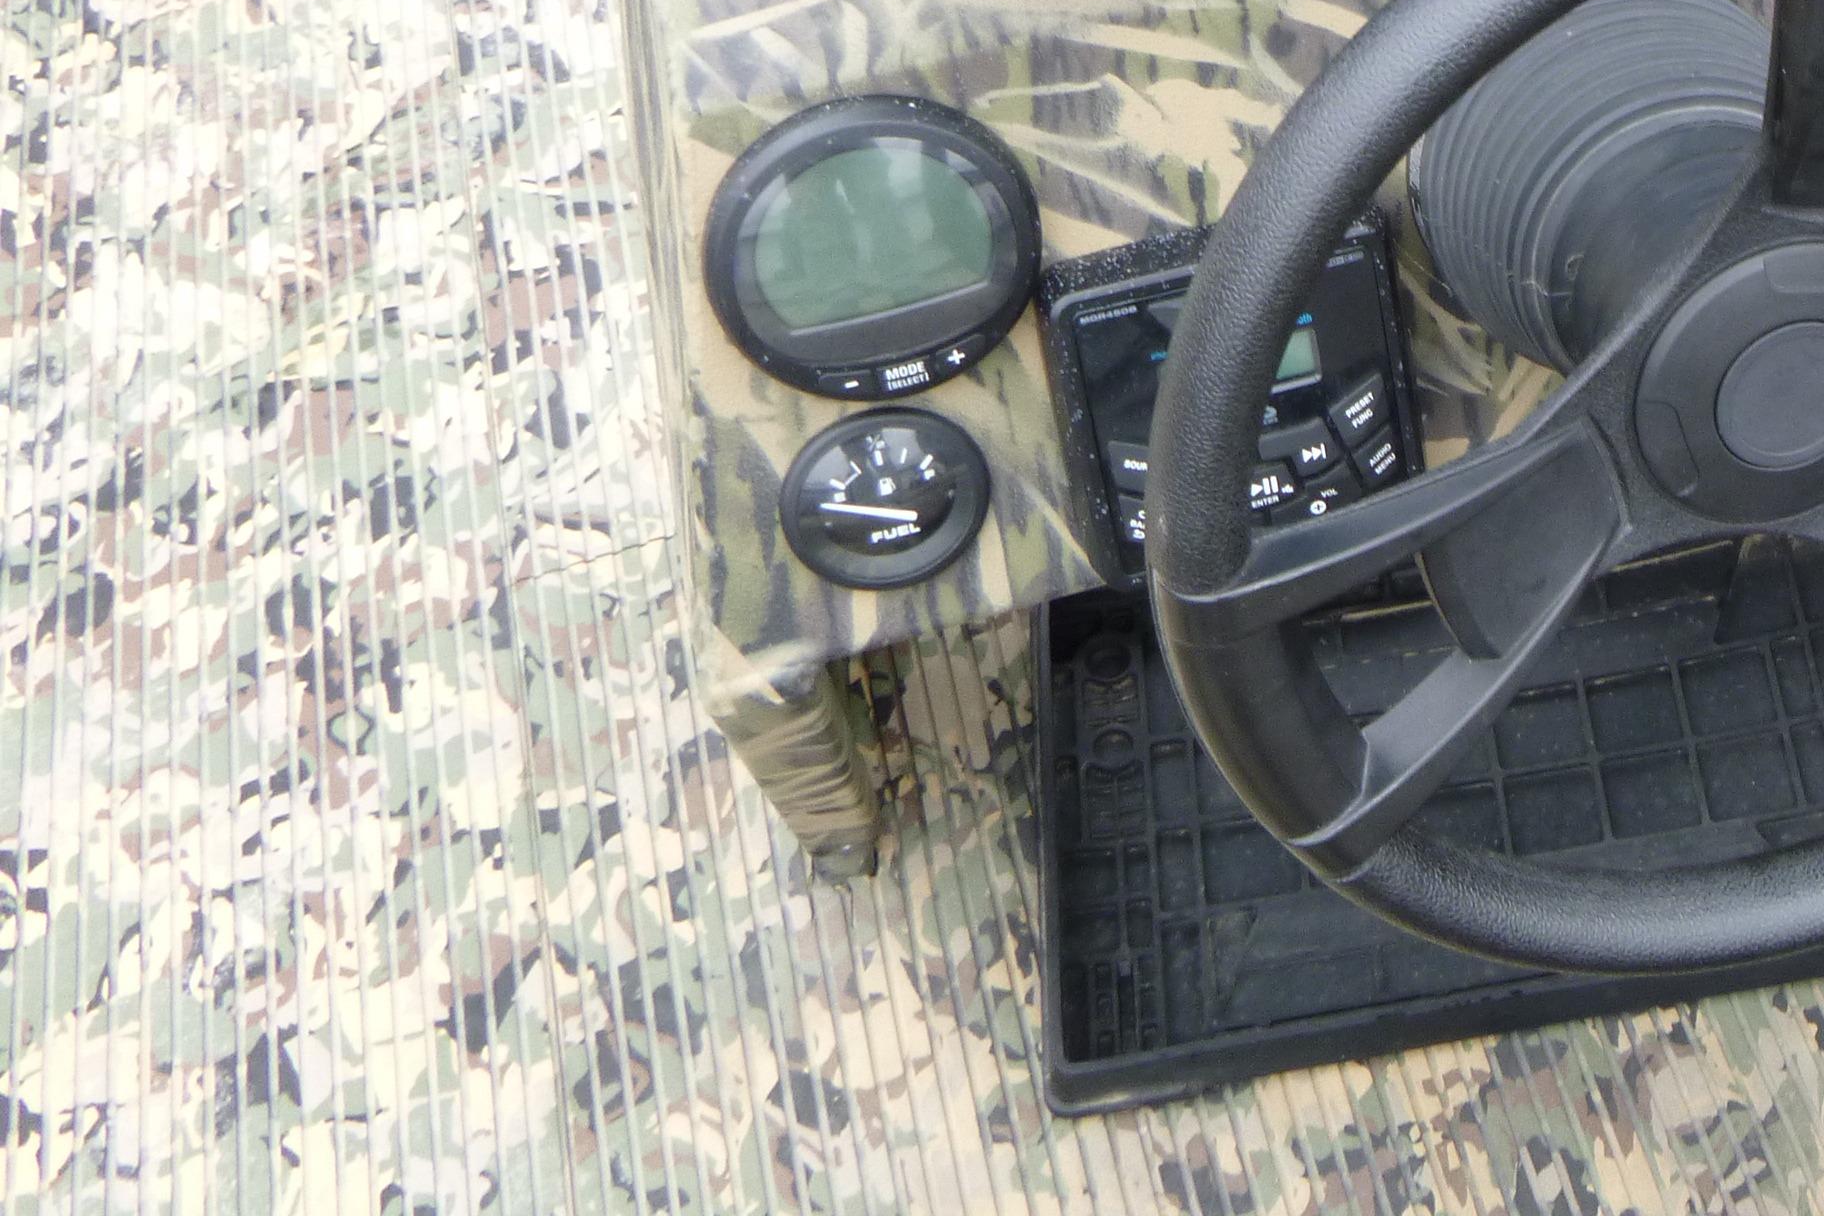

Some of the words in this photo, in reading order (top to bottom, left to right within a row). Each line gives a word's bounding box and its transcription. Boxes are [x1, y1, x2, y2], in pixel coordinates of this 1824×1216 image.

[885, 361, 925, 381] MODE
[1345, 392, 1374, 418] PRESET
[1352, 408, 1373, 428] FUNC
[1124, 459, 1148, 471] SOUR
[1369, 443, 1391, 467] AUDIO
[1375, 453, 1396, 475] MENU
[1251, 495, 1279, 509] ENTER
[1320, 488, 1338, 498] VOL
[871, 523, 921, 544] FUEL
